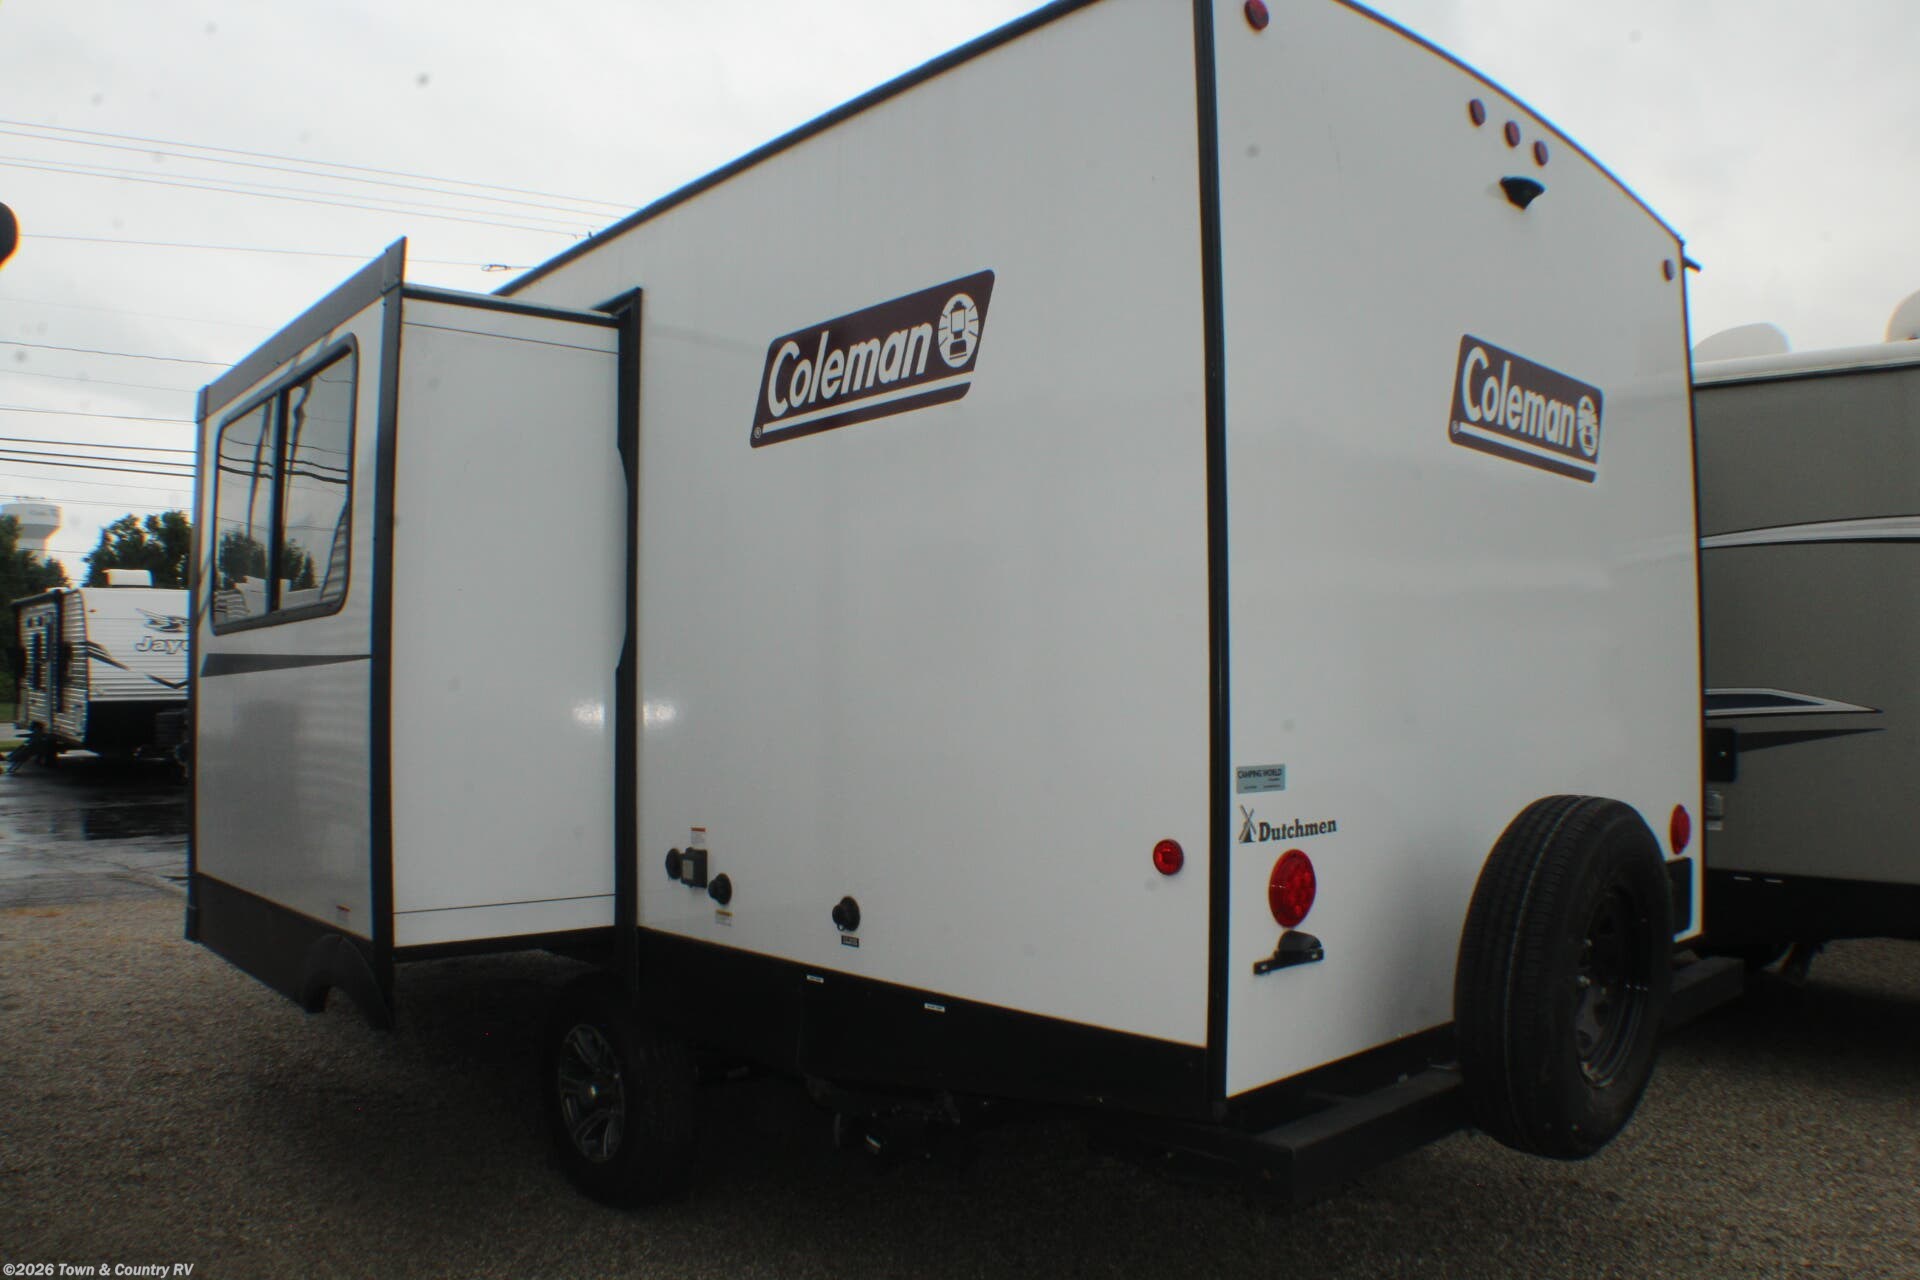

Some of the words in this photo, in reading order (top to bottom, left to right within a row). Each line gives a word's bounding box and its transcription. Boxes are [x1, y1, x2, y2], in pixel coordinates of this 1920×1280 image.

[768, 322, 933, 418] Coleman
[1462, 346, 1575, 449] Coleman
[1258, 818, 1337, 842] Dutchmen
